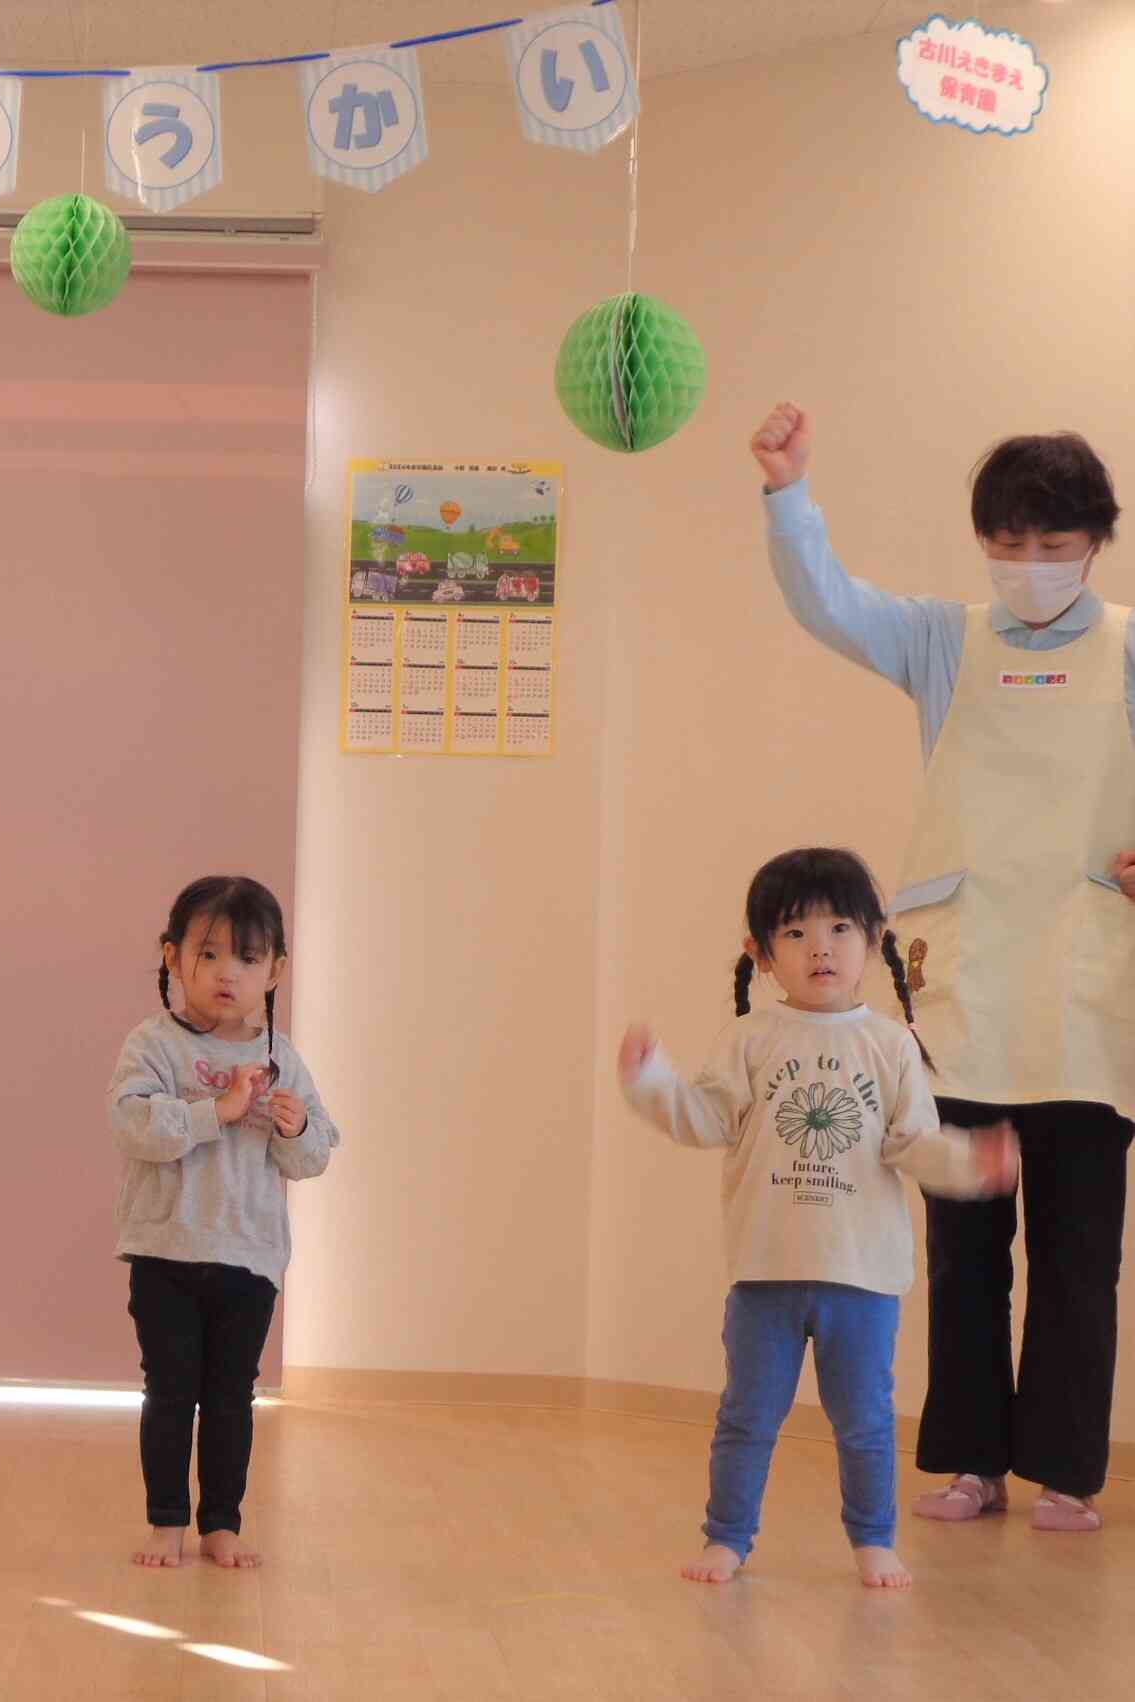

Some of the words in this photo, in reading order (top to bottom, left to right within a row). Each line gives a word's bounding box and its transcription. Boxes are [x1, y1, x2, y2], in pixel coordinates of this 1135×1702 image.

[817, 1053, 840, 1072] to
[852, 1072, 879, 1112] the
[771, 1173, 802, 1188] keep
[806, 1175, 857, 1193] smiling.
